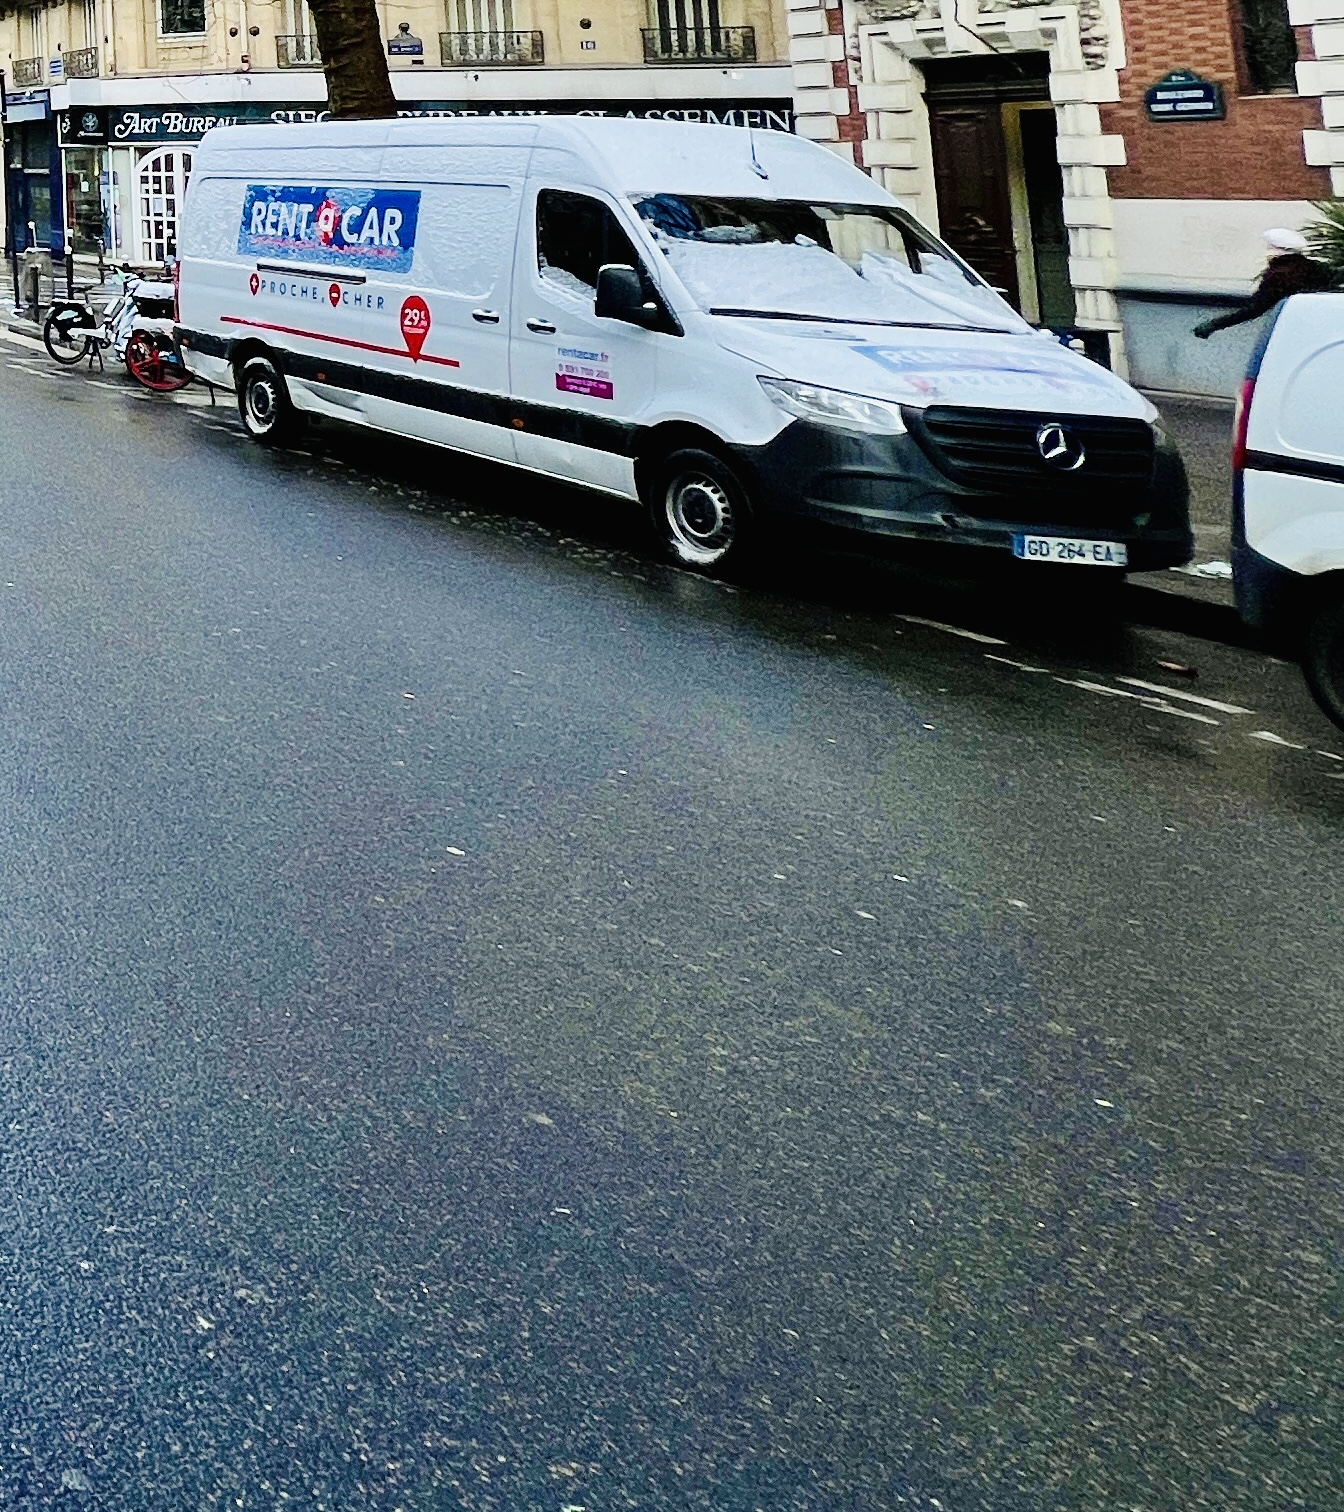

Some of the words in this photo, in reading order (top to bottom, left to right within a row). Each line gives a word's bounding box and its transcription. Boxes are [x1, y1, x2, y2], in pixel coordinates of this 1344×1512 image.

[250, 200, 314, 237] RENT
[341, 205, 404, 247] CAR
[342, 290, 385, 310] CHER
